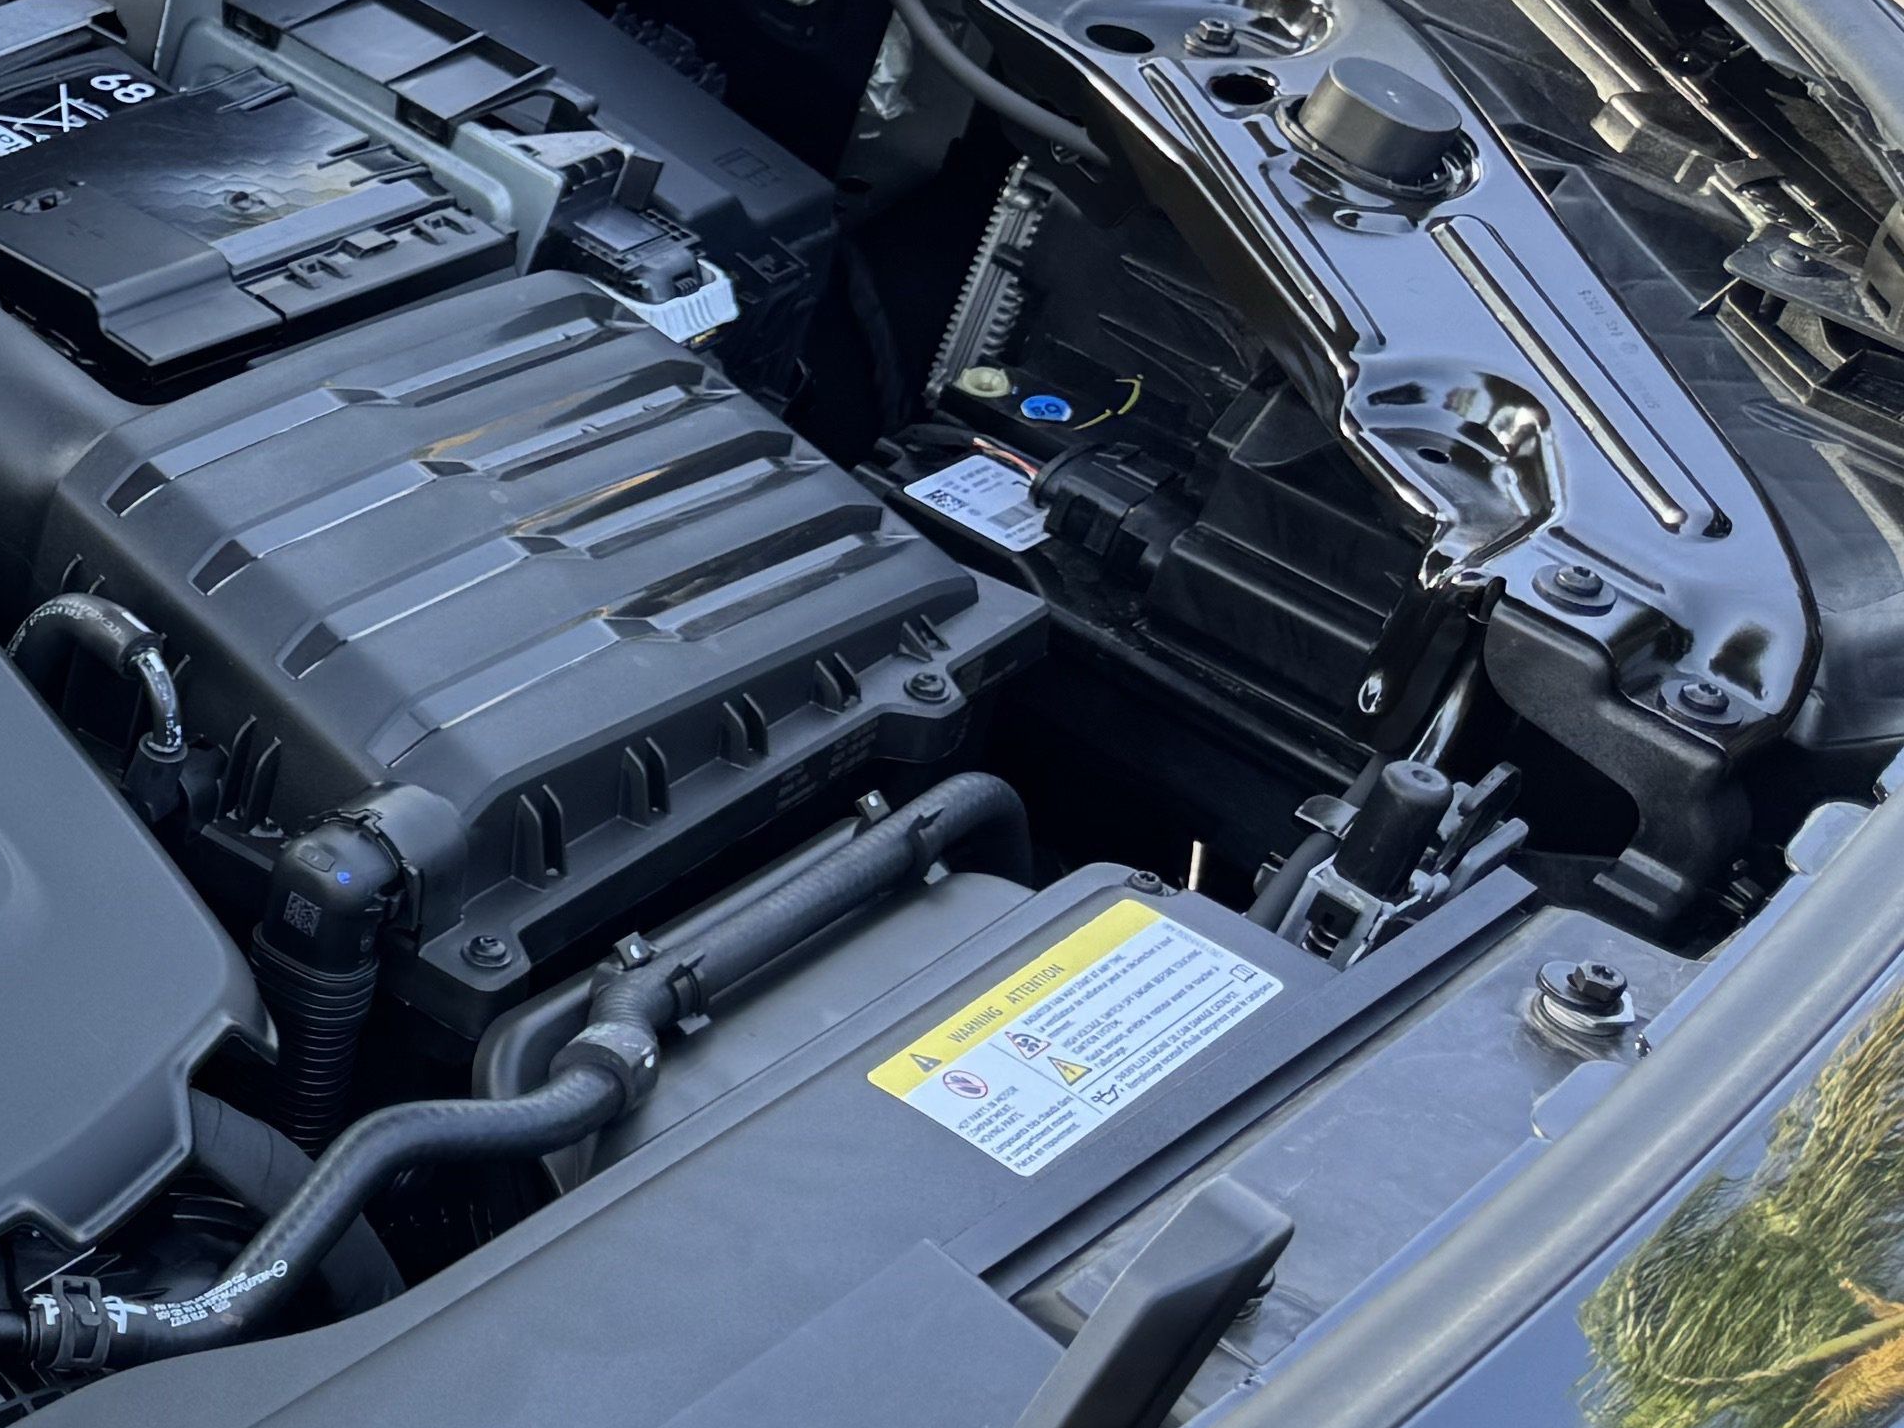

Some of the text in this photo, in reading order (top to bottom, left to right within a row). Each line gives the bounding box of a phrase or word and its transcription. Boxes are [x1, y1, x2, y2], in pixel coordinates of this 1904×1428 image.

[91, 74, 155, 103] 68
[947, 963, 1065, 1044] WARNING ATTENTION
